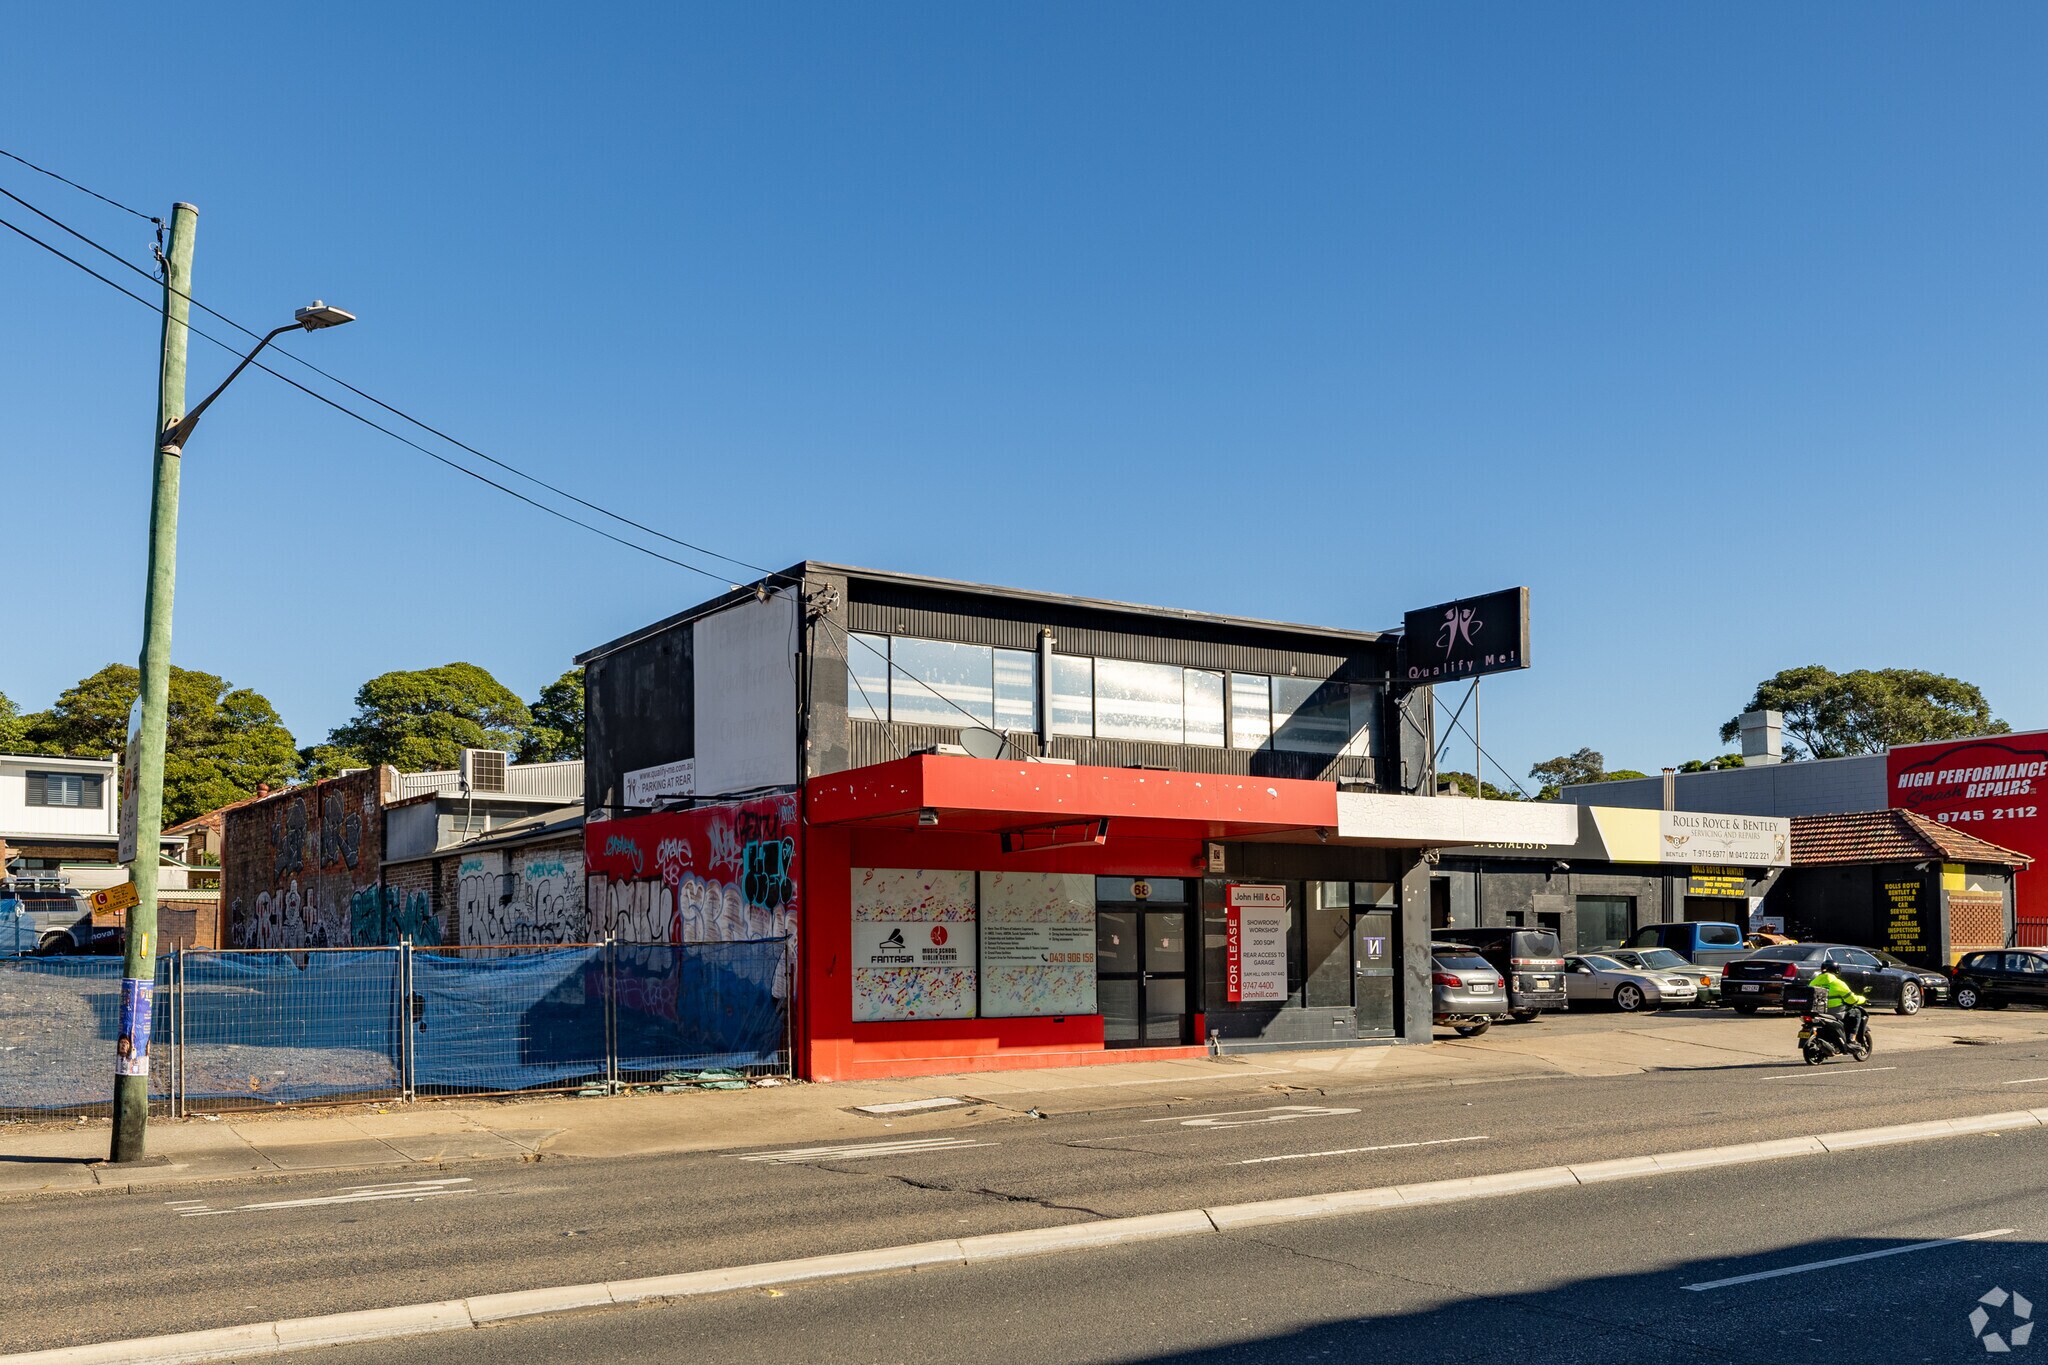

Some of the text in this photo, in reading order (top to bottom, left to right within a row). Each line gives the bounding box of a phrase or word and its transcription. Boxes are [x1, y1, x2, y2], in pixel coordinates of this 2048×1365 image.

[1408, 650, 1515, 679] Qualify Me!
[639, 762, 694, 780] www.qualify-me.com.au
[1897, 761, 2048, 789] HIGH PERFORMANCE
[641, 774, 692, 793] PARKING AT REAR
[1906, 779, 2031, 808] Smash REPAIRS
[1937, 809, 1985, 823] 9745
[1992, 806, 2038, 820] 2112
[1673, 815, 1779, 832] ROLLS ROYCE & BENTLEY
[1691, 830, 1761, 840] SERVICING AND REPAIRS
[1712, 850, 1726, 858] 6977
[1749, 852, 1760, 860] 222
[1760, 852, 1770, 860] 221
[1691, 864, 1705, 874] ROLLS
[1706, 865, 1721, 875] ROYCE
[1134, 884, 1149, 896] 68
[97, 893, 106, 904] C
[1234, 892, 1281, 901] John Hill & Co
[104, 899, 129, 908] CLEARWAY
[938, 947, 957, 955] SCHOOL
[1229, 919, 1238, 993] FOR LEASE
[870, 955, 914, 964] FANTASIA
[1049, 952, 1094, 963] 0431 906 158
[1242, 981, 1275, 990] 9747 4400
[1242, 991, 1279, 1000] johnhill.com
